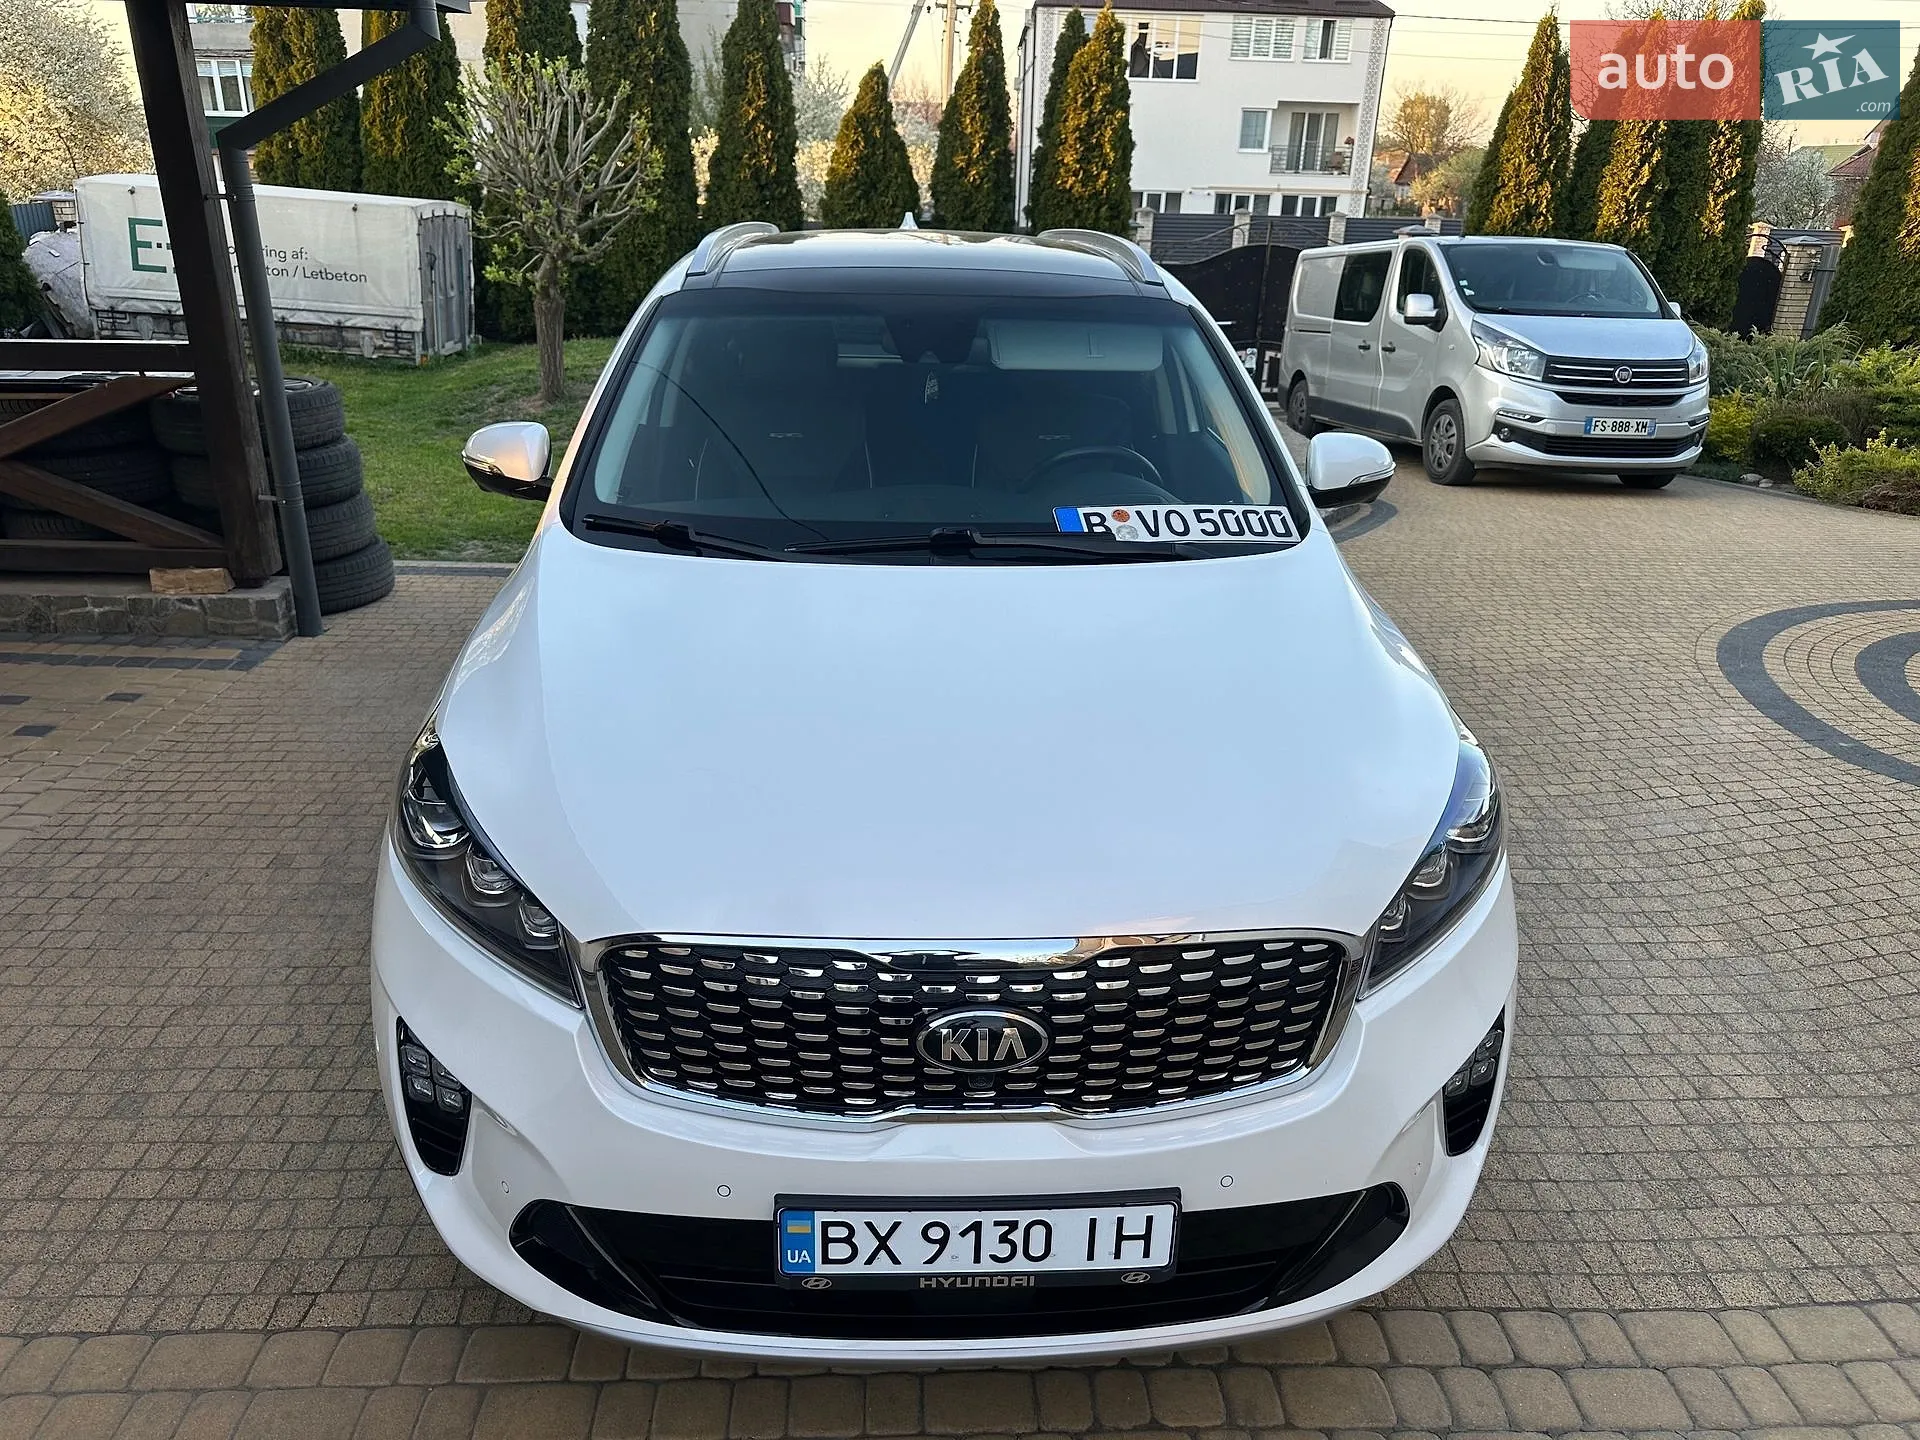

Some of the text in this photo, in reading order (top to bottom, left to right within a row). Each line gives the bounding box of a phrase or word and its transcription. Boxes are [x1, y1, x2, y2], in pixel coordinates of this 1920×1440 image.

[291, 246, 308, 260] af:
[303, 266, 367, 283] Letbeton
[940, 1028, 1027, 1061] KIA
[821, 1215, 1154, 1265] BX 9130 IH
[787, 1249, 811, 1263] UA
[919, 1276, 1035, 1289] HYUNDAI
